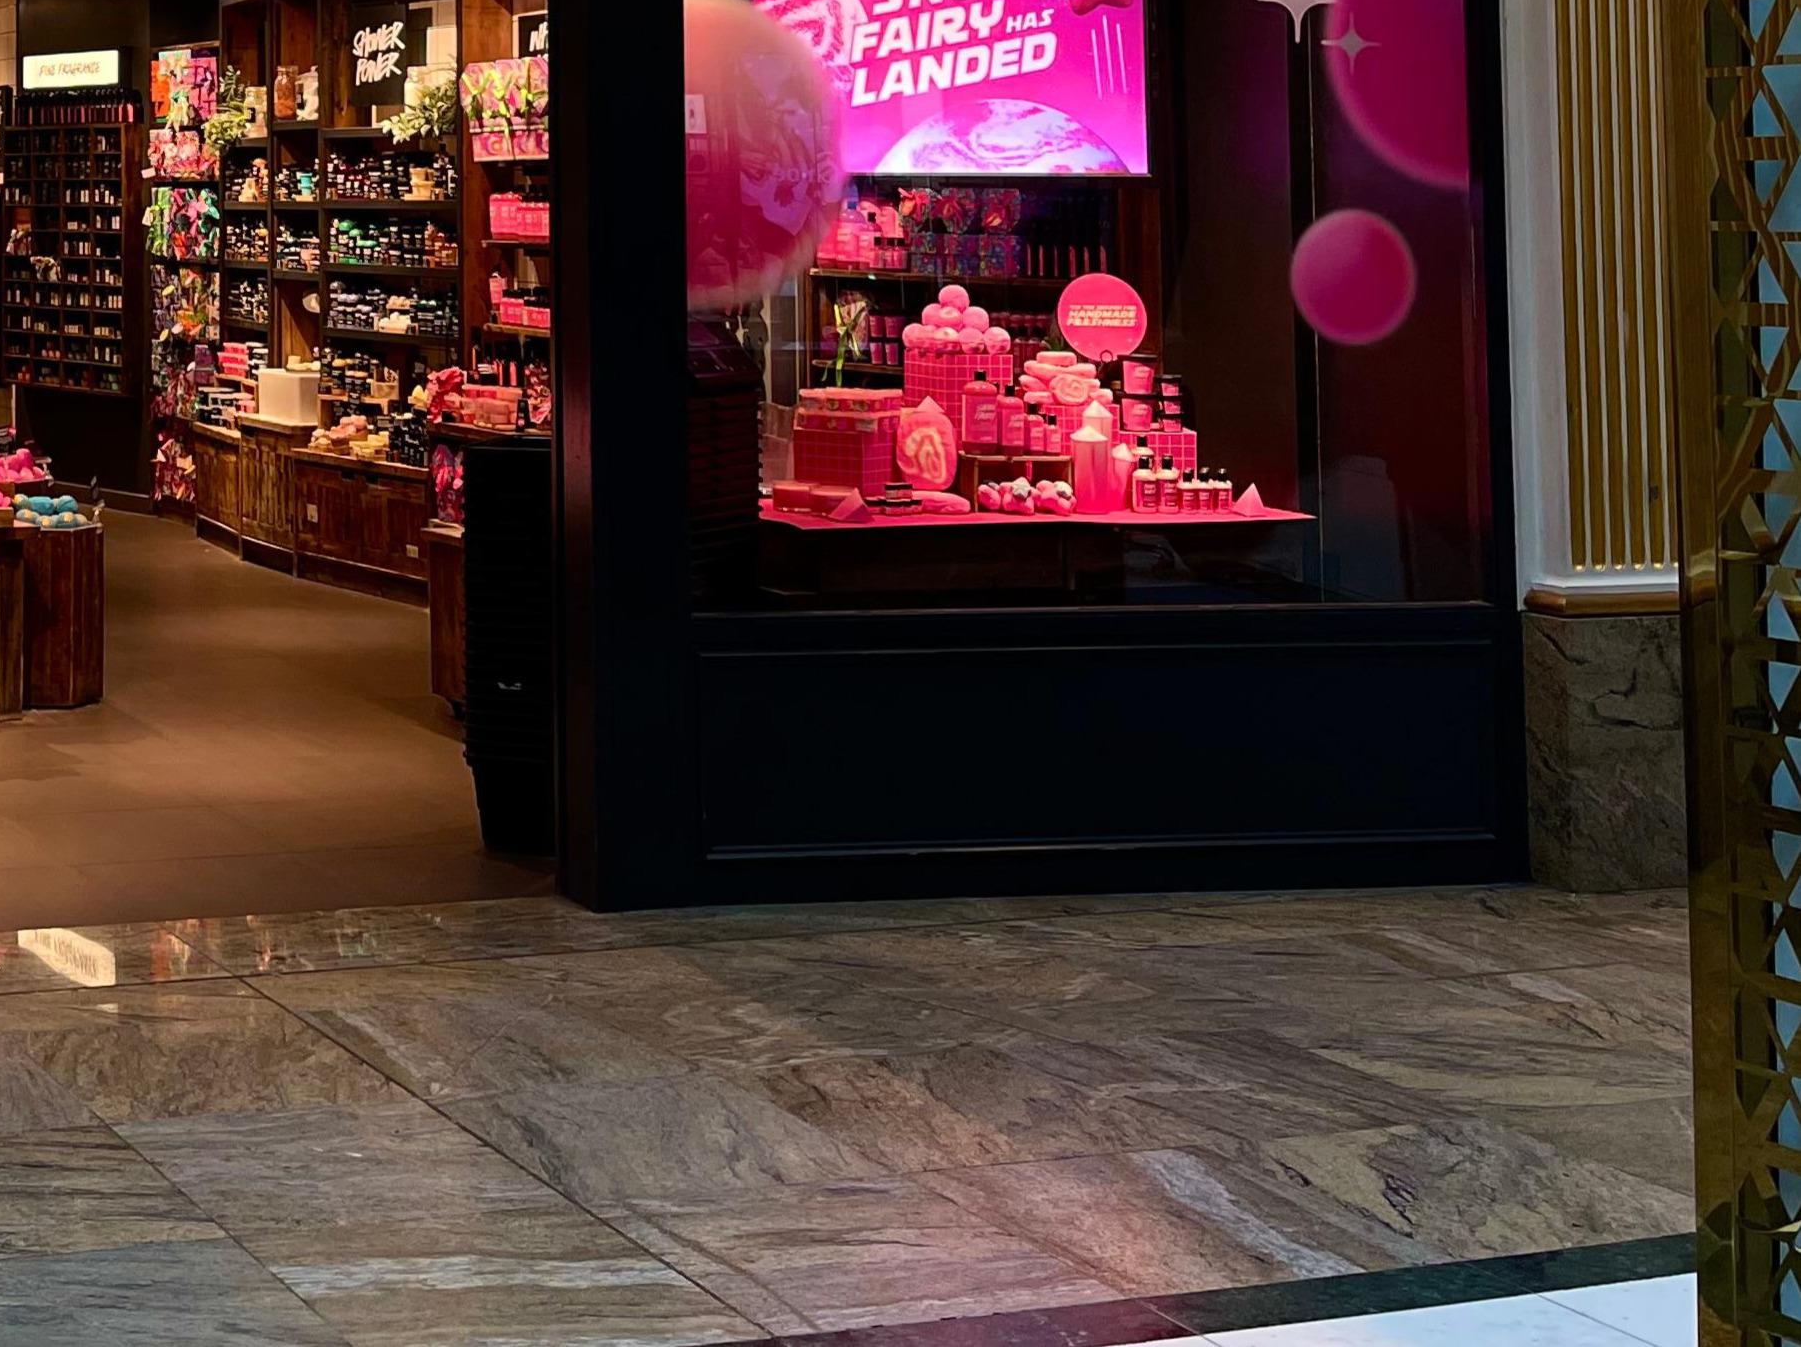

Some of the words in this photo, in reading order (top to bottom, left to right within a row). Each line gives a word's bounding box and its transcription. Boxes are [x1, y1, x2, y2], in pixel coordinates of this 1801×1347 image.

[1005, 9, 1055, 33] HAS
[352, 21, 406, 58] SHOWER
[355, 52, 403, 86] POWER
[849, 31, 1058, 108] LANDED
[1068, 310, 1137, 318] HANDMADE
